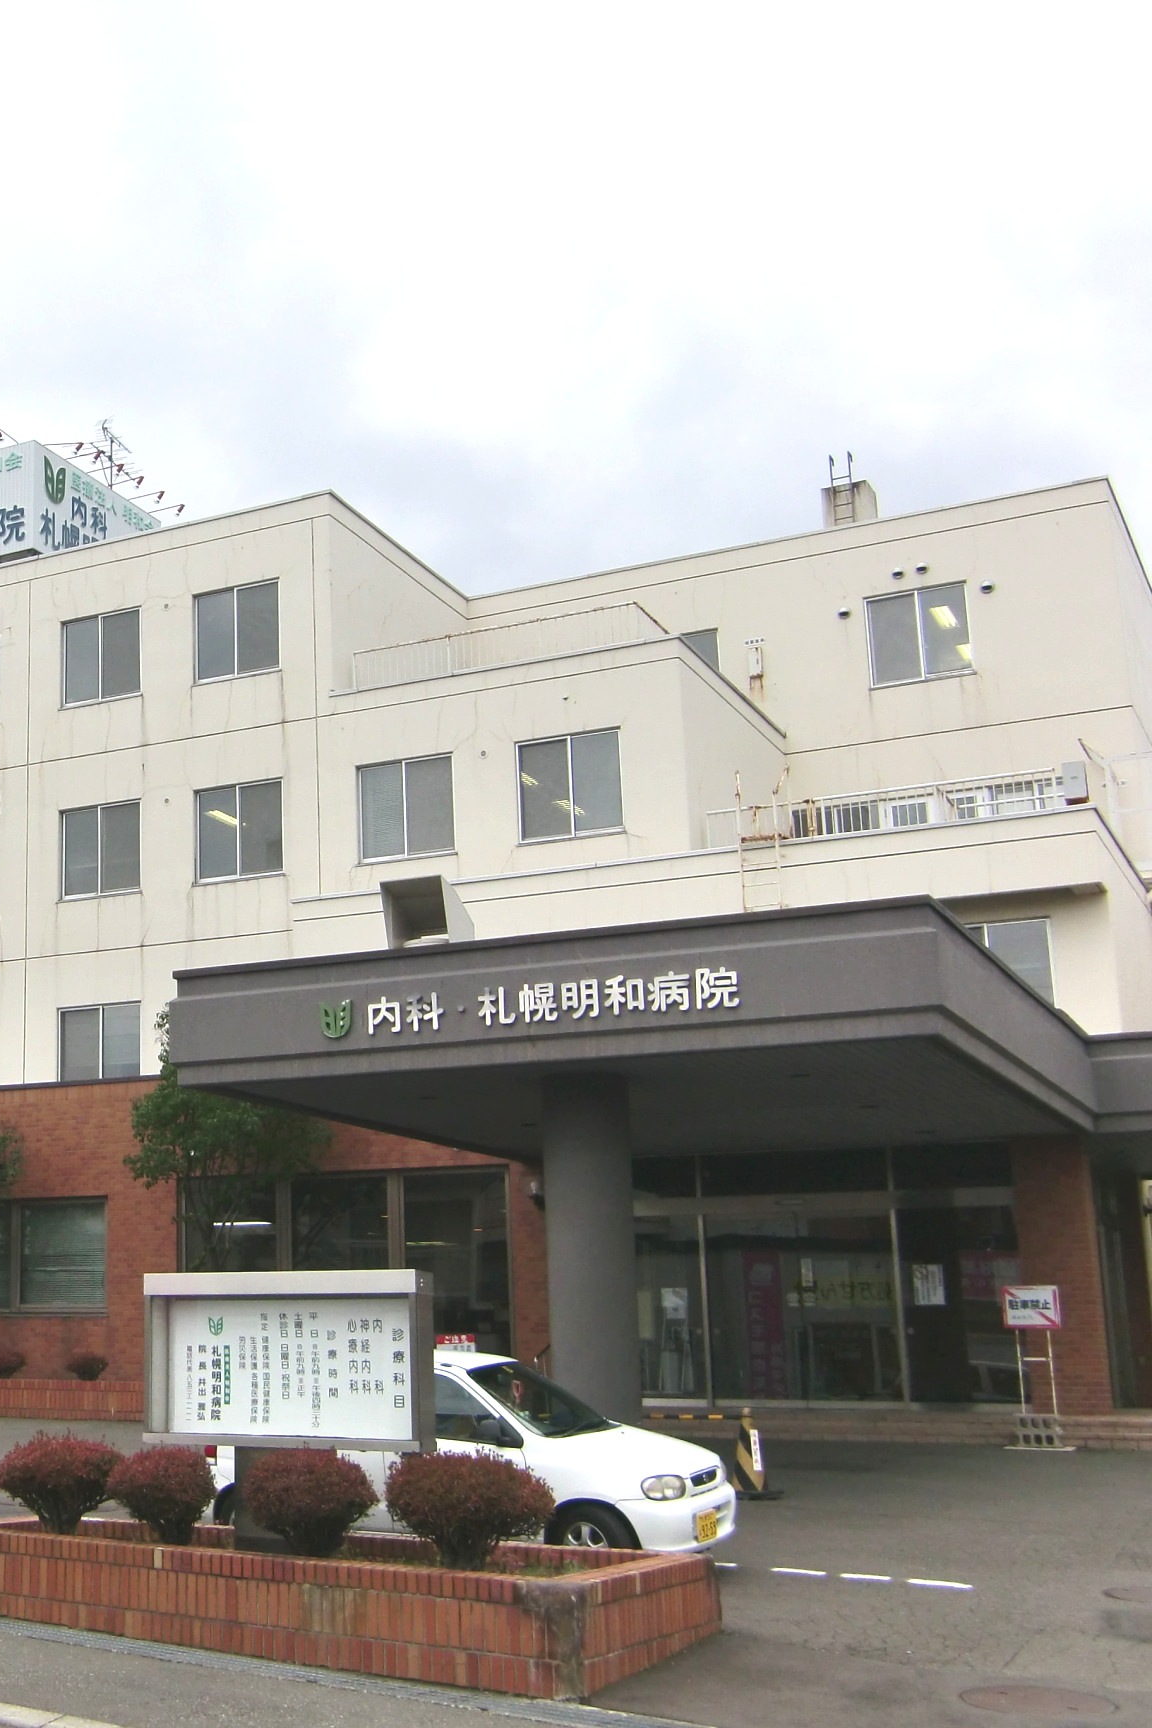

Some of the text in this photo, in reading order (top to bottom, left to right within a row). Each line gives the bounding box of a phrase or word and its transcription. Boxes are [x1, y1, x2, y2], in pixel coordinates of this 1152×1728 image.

[71, 495, 108, 540] 内科
[198, 1344, 207, 1371] 院長
[279, 1312, 288, 1338] 休診日
[294, 1311, 303, 1338] 土曜日
[347, 1318, 359, 1394] 心療内科
[359, 1317, 371, 1395] 神経内科
[210, 1344, 222, 1421] 札幌明和病院
[326, 1329, 338, 1398] 診療時間
[391, 1327, 405, 1409] 診療科目
